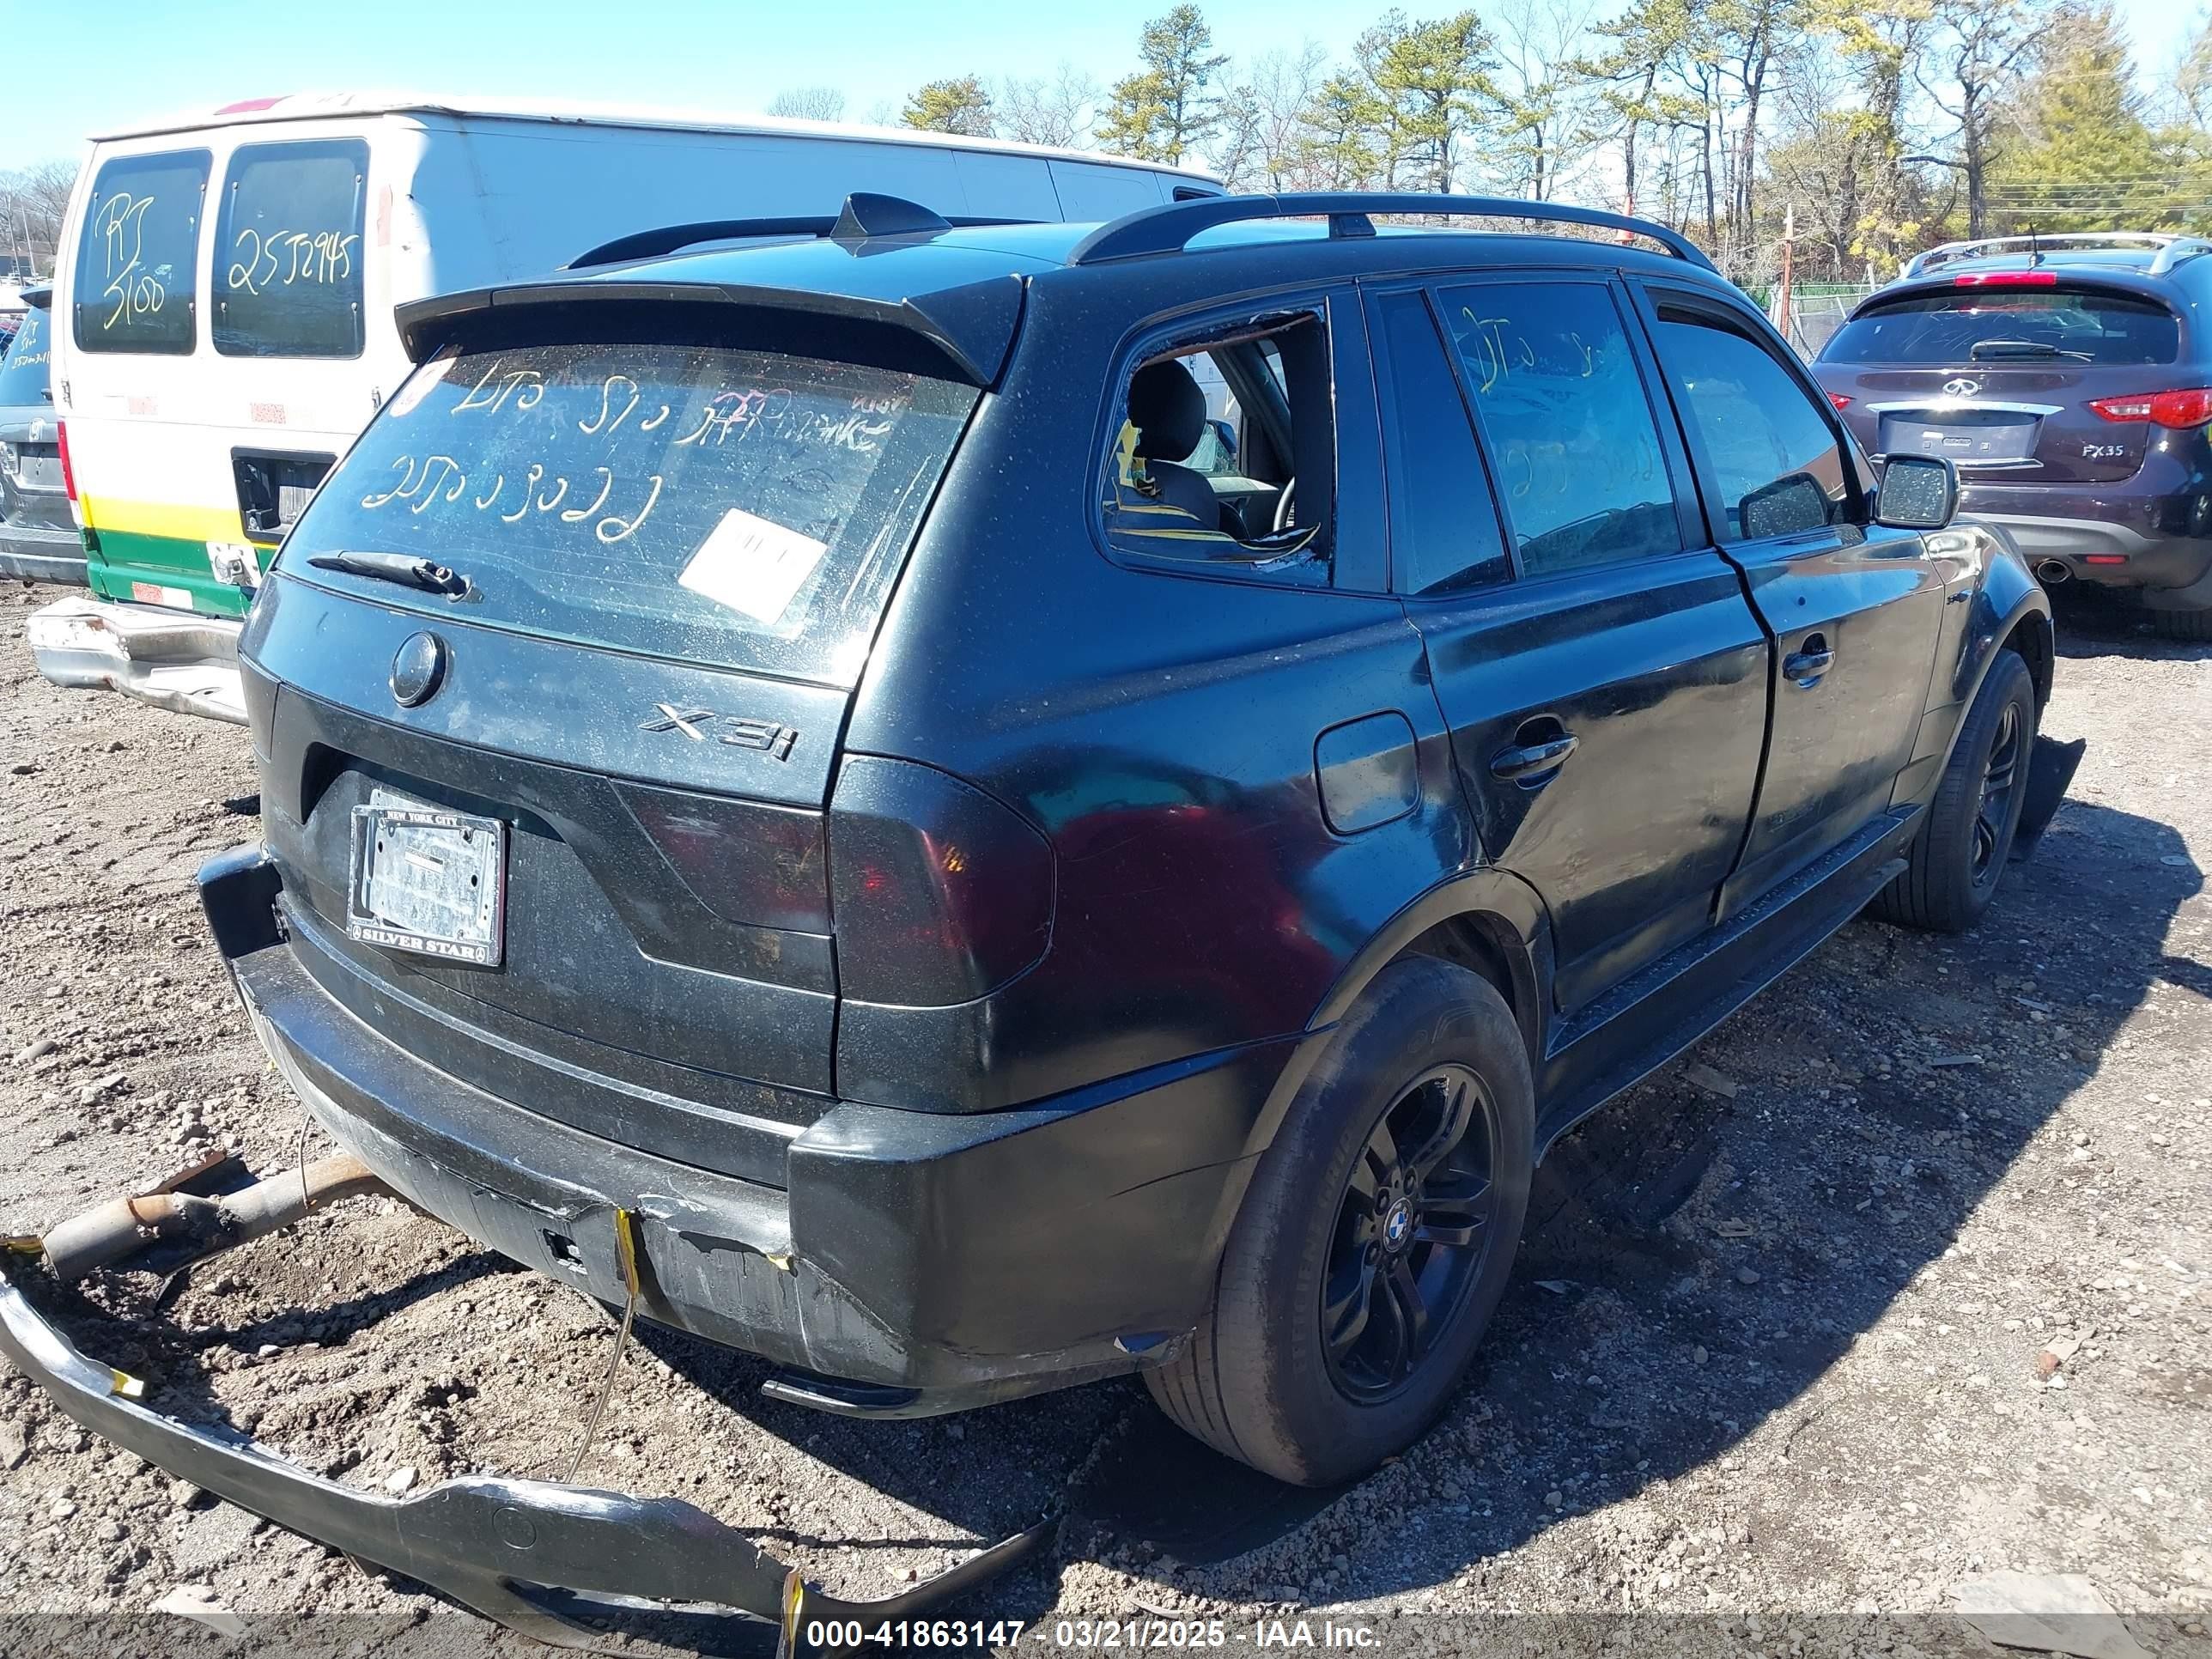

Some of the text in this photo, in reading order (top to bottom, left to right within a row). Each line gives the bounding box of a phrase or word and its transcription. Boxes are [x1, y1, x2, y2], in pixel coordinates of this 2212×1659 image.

[2081, 444, 2124, 459] FX35
[386, 811, 458, 826] NEW YORK CITY
[362, 927, 475, 959] SILVER STAR
